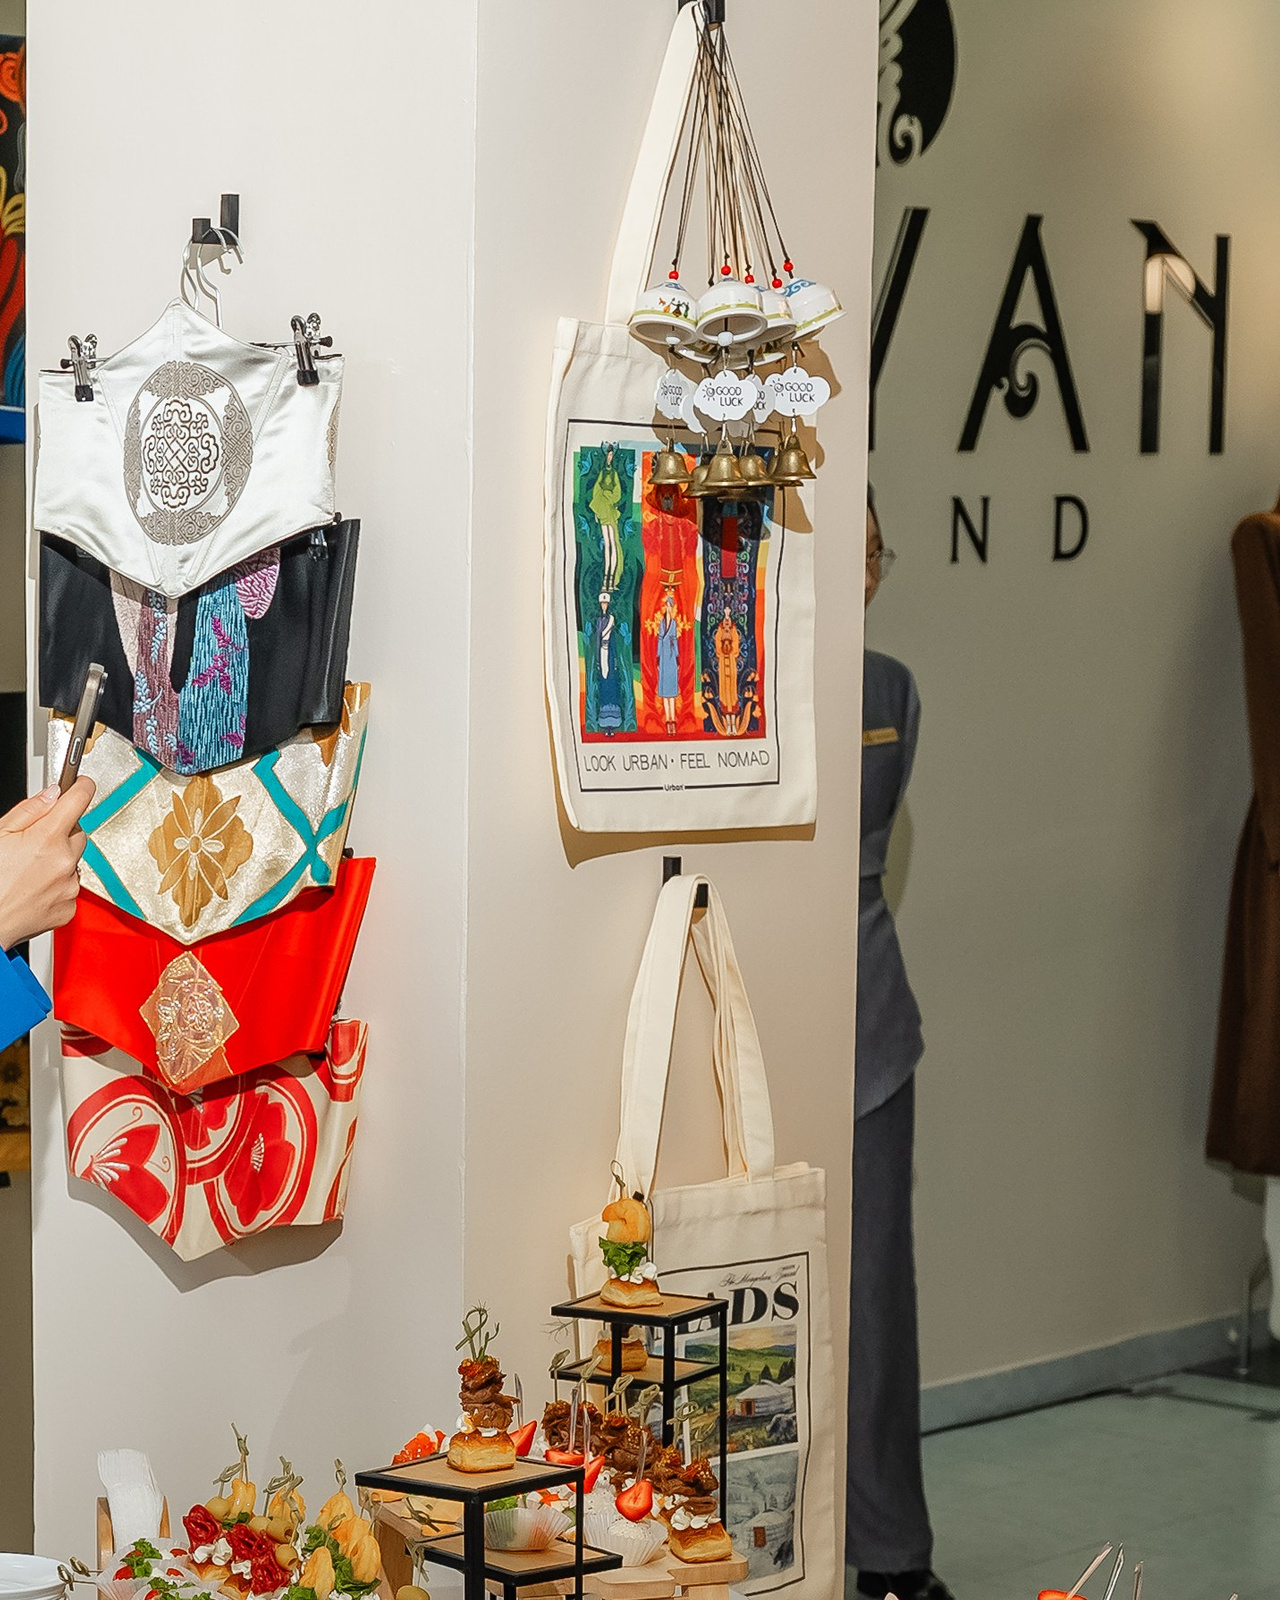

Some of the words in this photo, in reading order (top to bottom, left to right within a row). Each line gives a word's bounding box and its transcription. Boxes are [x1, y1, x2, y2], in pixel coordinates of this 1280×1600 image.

[716, 386, 742, 396] GOOD
[785, 382, 813, 392] GOOD
[720, 397, 744, 407] LUCK
[789, 393, 815, 403] LUCK
[583, 754, 617, 772] LOOK
[680, 752, 710, 769] FEEL
[718, 750, 770, 768] NOMAD
